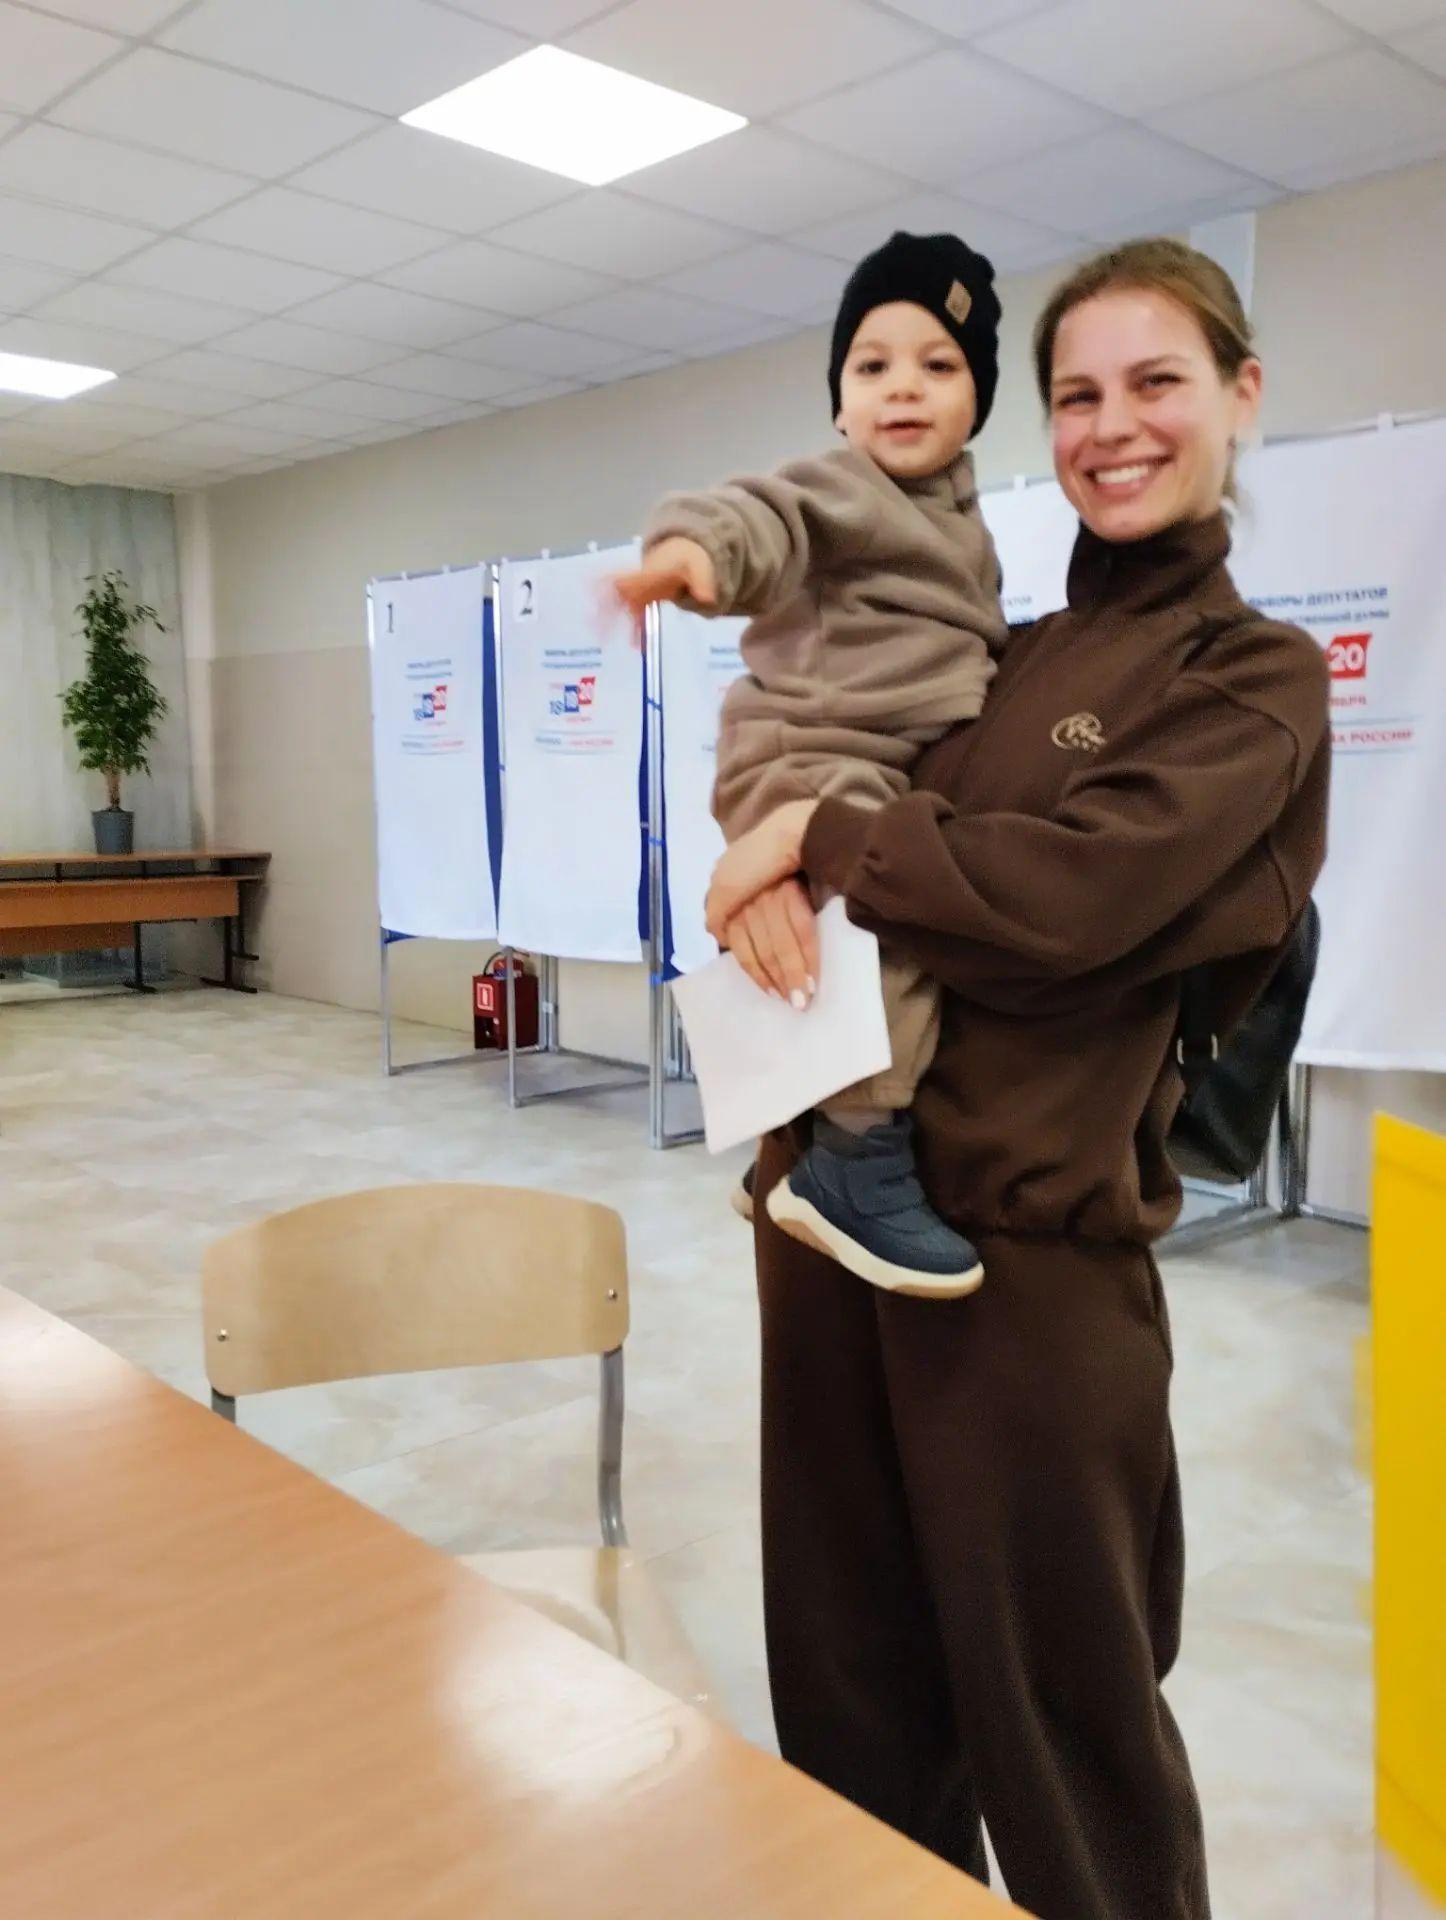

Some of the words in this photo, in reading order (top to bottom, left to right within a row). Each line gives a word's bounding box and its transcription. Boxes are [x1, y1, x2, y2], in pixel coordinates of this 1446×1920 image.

[520, 579, 532, 616] 2
[386, 602, 394, 634] 1
[1330, 643, 1365, 671] 20
